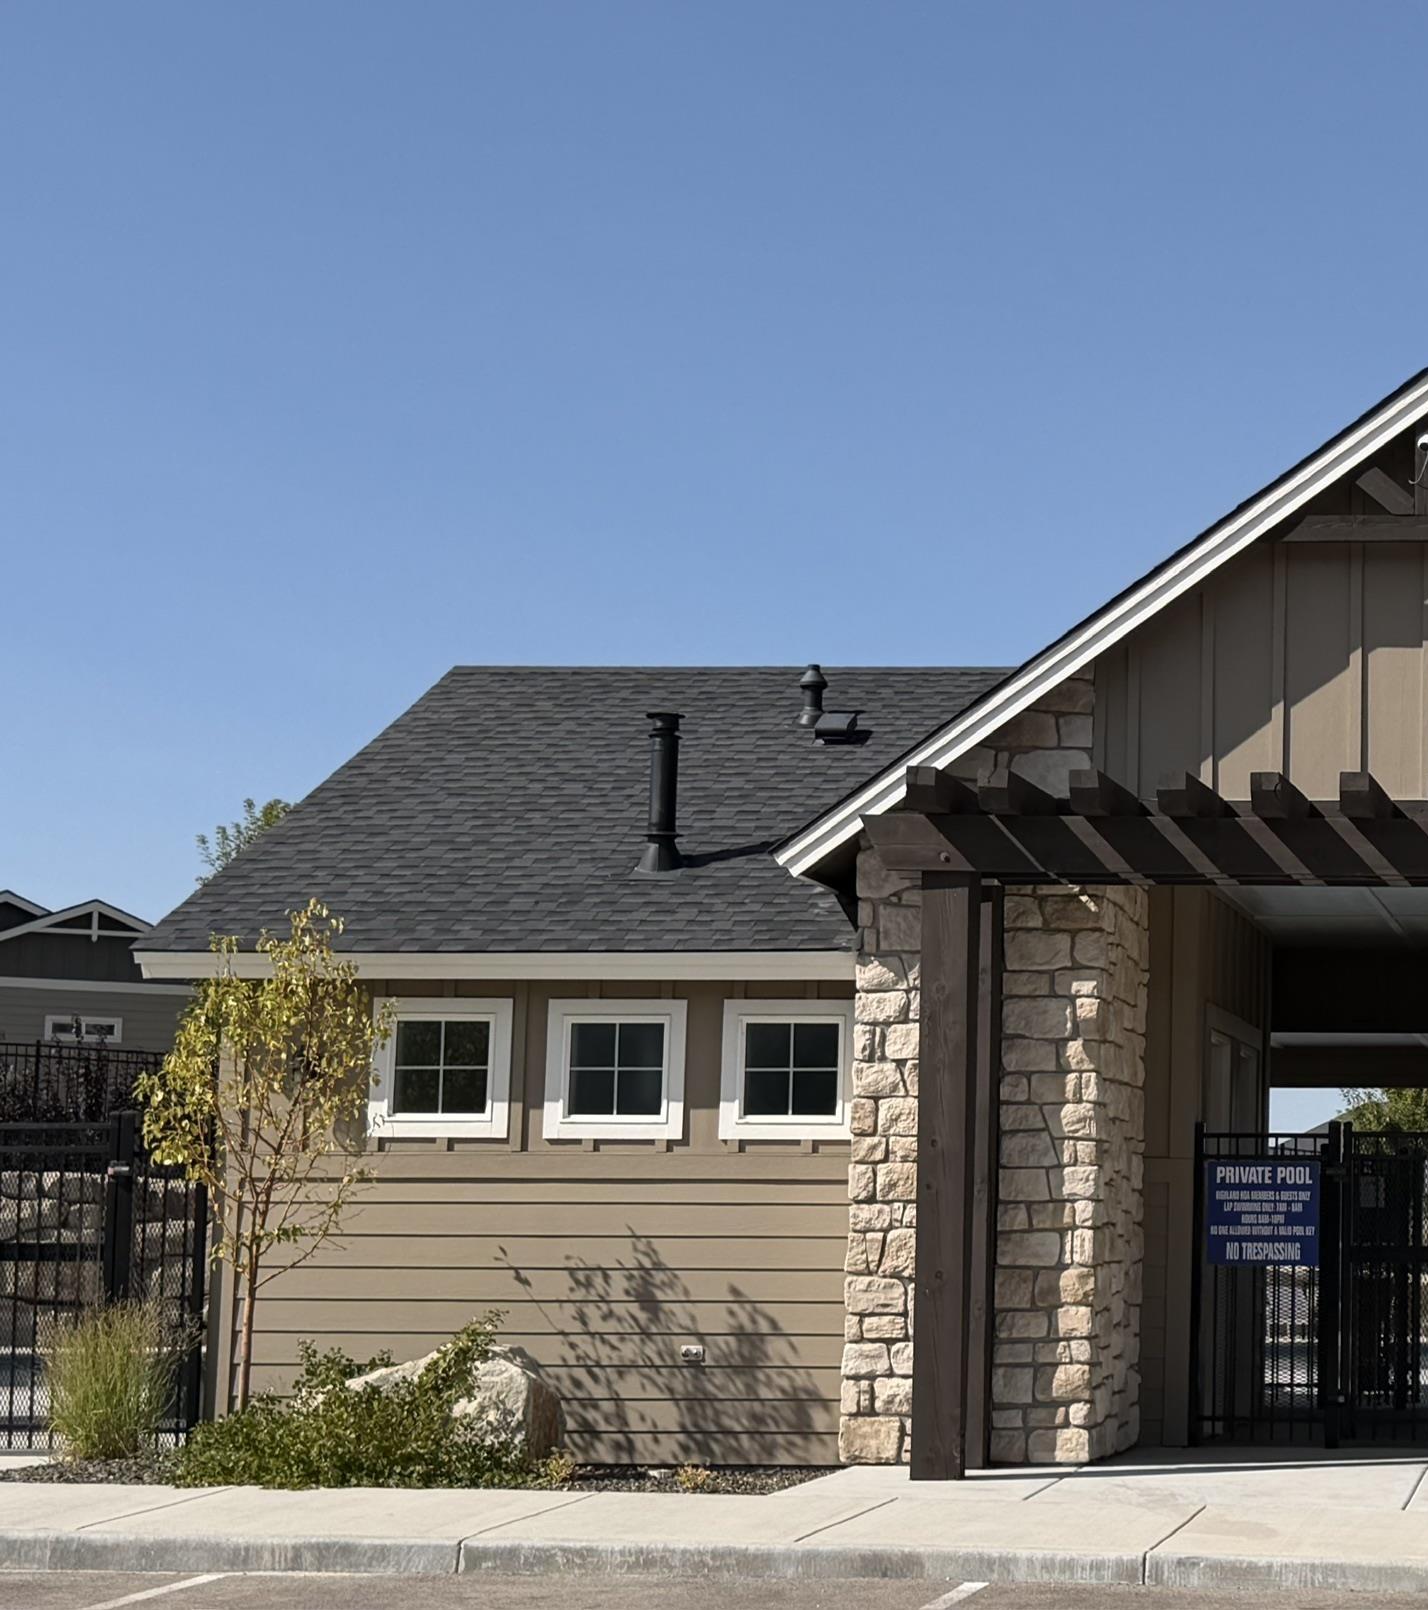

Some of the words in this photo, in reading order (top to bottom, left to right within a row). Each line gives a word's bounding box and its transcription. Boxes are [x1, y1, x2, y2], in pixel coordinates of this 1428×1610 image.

[1216, 1166, 1272, 1184] PRIVATE
[1277, 1166, 1312, 1184] POOL
[1224, 1202, 1233, 1212] LAP
[1219, 1226, 1228, 1236] ONE
[1230, 1226, 1251, 1236] ALLOWED
[1252, 1226, 1273, 1236] WITHOUT
[1293, 1226, 1304, 1236] POOL
[1226, 1242, 1239, 1260] NO
[1242, 1242, 1301, 1260] TRESPASSING
